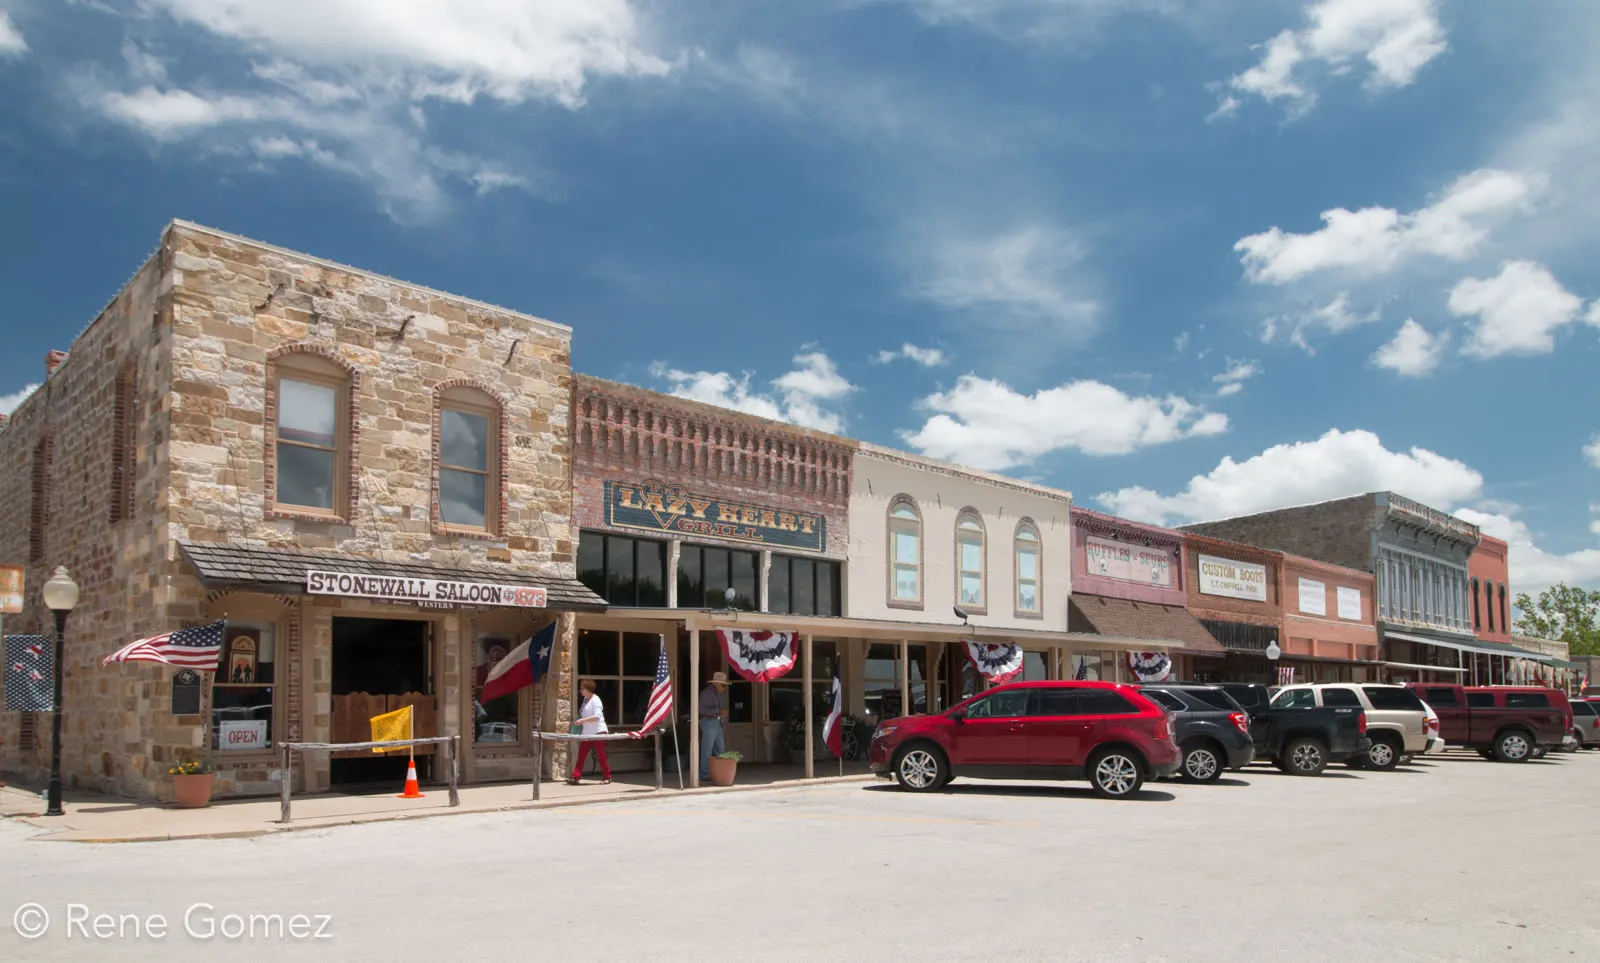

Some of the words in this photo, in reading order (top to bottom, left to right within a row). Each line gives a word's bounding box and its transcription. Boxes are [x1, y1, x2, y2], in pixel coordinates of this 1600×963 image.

[619, 488, 710, 518] LAZY
[717, 503, 816, 534] HEART
[677, 518, 763, 541] GRILL
[1202, 562, 1235, 579] CUSTOM
[1240, 569, 1264, 584] BOOTS
[310, 572, 430, 598] STONEWALL
[435, 582, 502, 603] SALOON
[514, 588, 545, 607] 1873
[417, 601, 454, 609] WESTERN
[229, 730, 258, 744] OPEN
